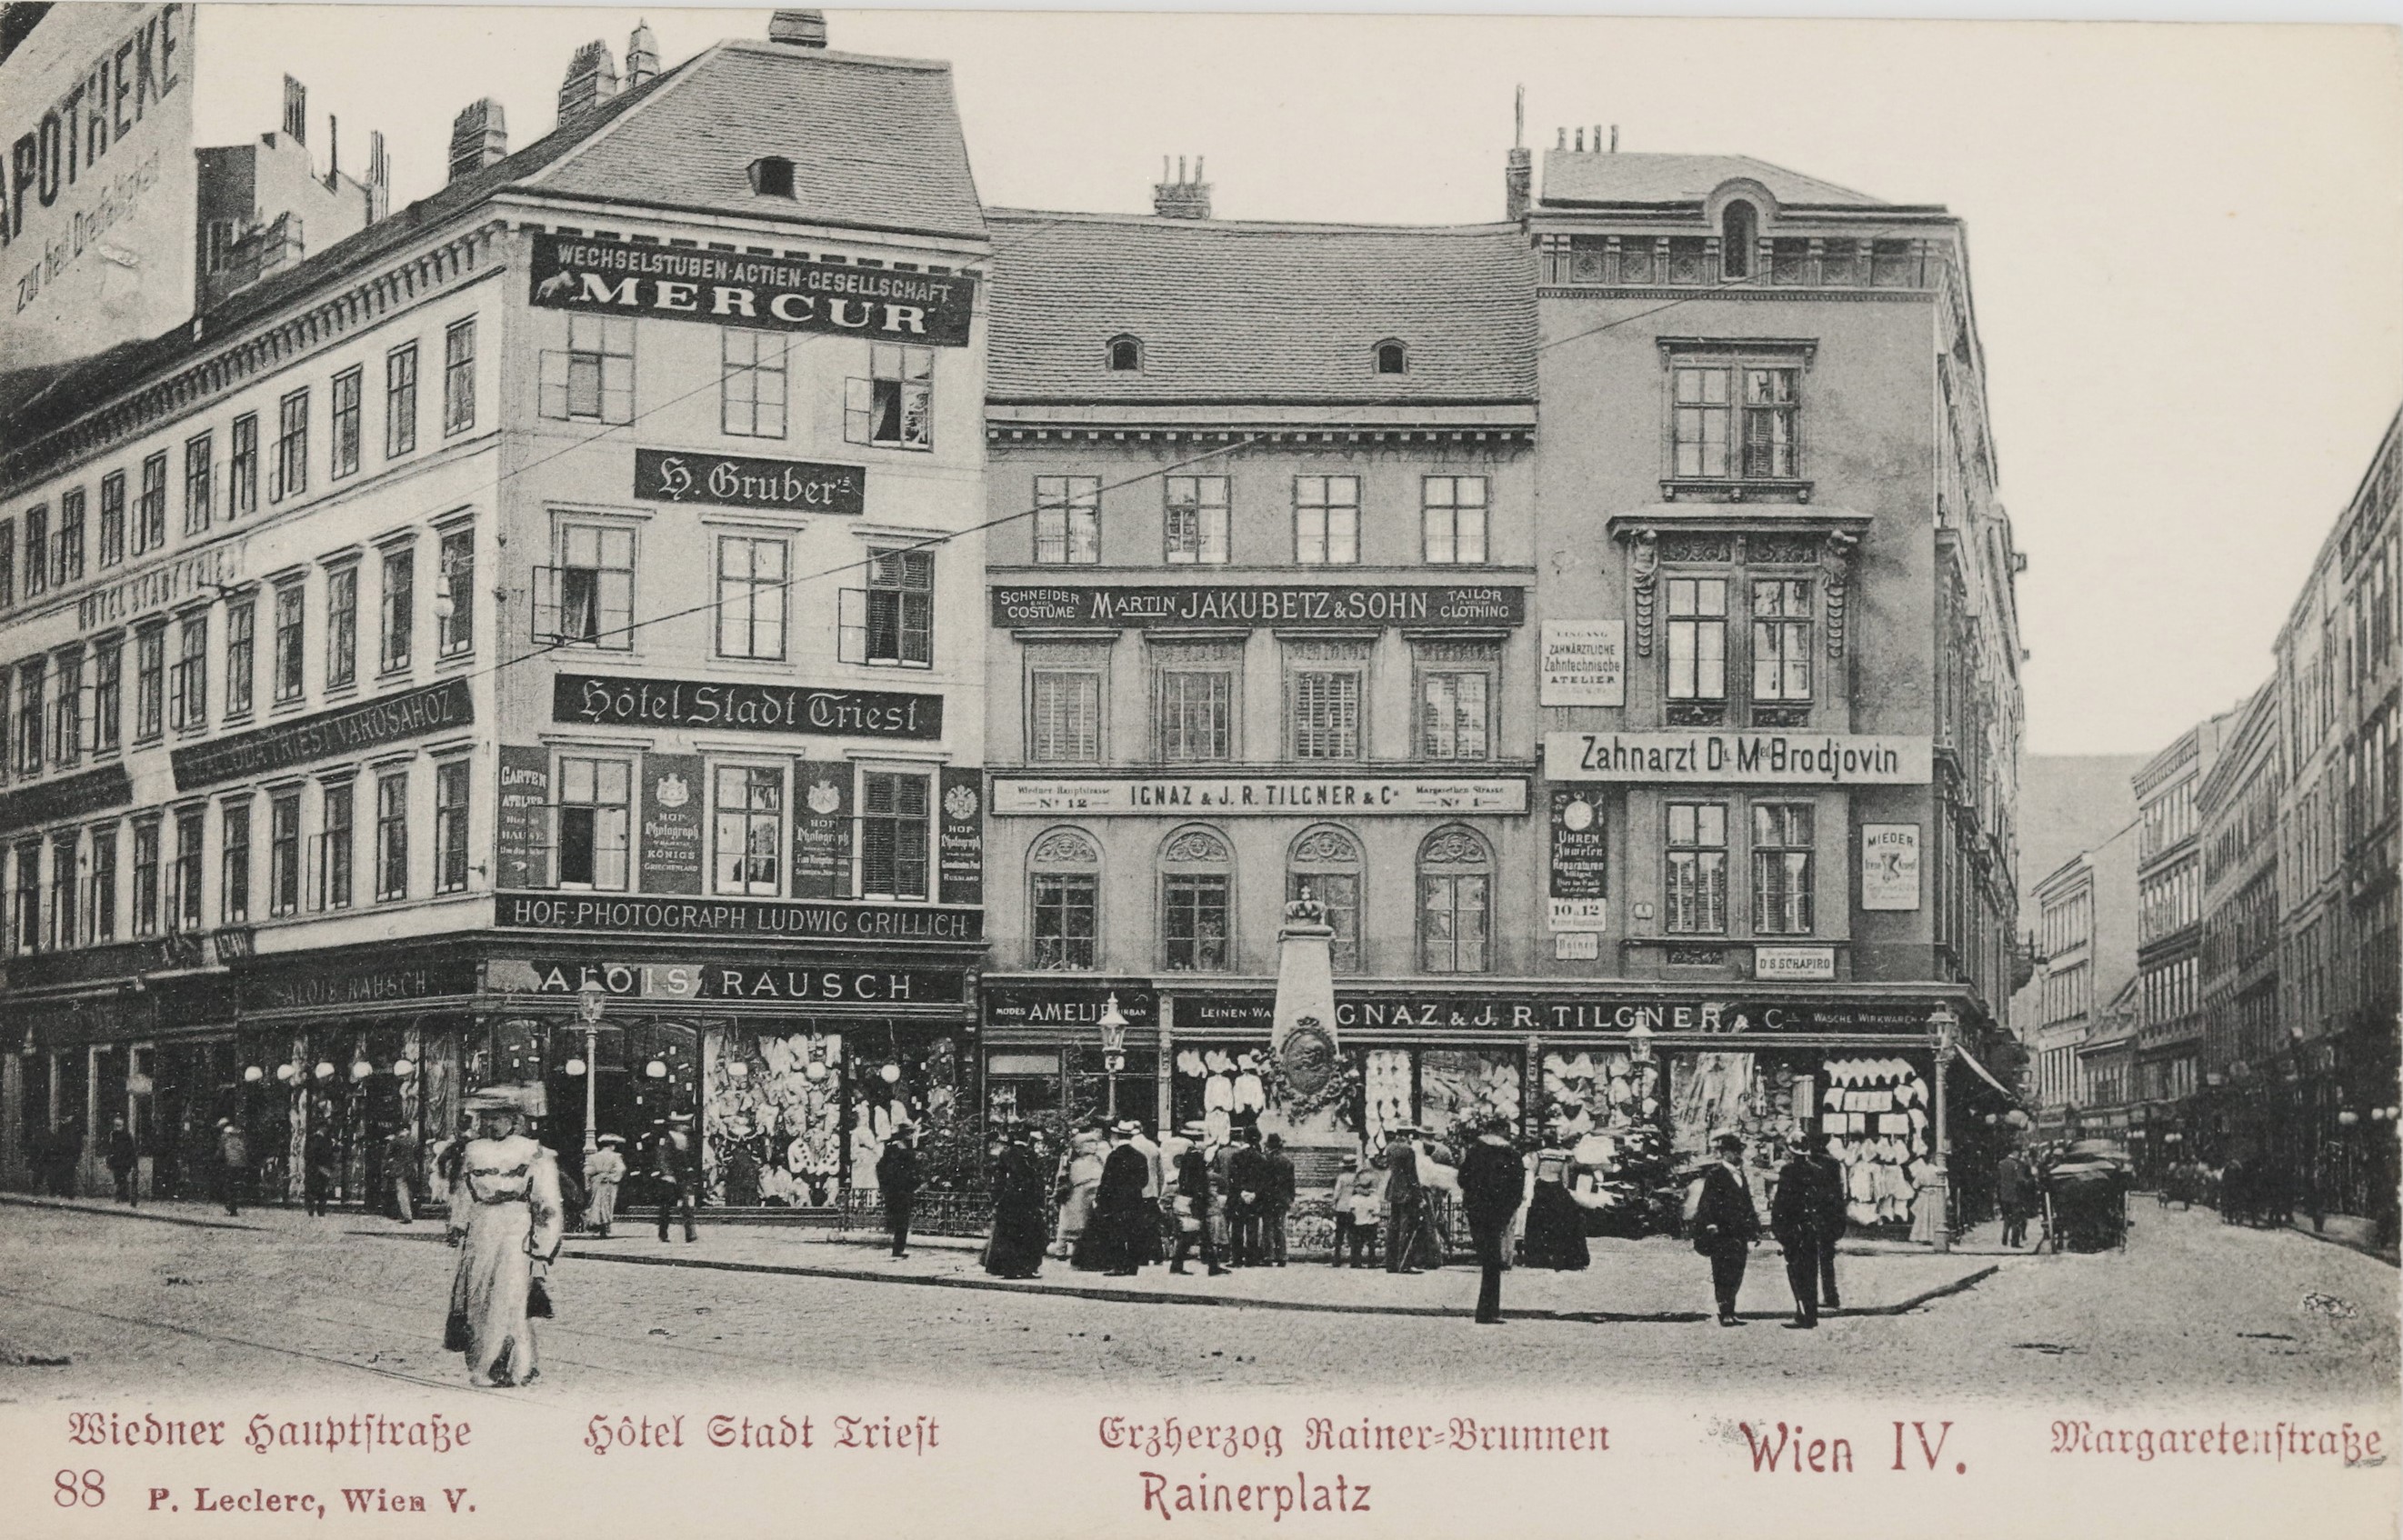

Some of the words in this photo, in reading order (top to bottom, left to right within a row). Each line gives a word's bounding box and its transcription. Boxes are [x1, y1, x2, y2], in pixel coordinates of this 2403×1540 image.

[657, 456, 701, 501] H.
[1000, 589, 1080, 605] SCHNEIDER
[1447, 589, 1502, 602] TAILOR
[1181, 592, 1330, 619] JAKUBETZ
[1348, 592, 1427, 619] SOHN
[1440, 605, 1509, 618] CLOTHING
[1549, 643, 1615, 655] ZAHNÄRZTLICHE
[1545, 656, 1620, 672] Zahntechnische
[1551, 675, 1615, 684] ATELIER
[686, 686, 796, 725] Stadt
[806, 693, 916, 732] Triest
[1580, 735, 1697, 773] Zahnarzt
[1771, 737, 1898, 782] Brodjovin
[501, 765, 547, 789] GARTEN
[1067, 798, 1088, 808] 12
[1130, 785, 1192, 806] IGNAZ
[1201, 793, 1213, 805] &
[1218, 786, 1235, 806] J.
[1242, 785, 1259, 806] R.
[1266, 785, 1356, 806] TILGNER
[1364, 792, 1375, 805] &
[645, 820, 699, 840] Photograph
[1558, 830, 1600, 844] UHREN
[1867, 832, 1914, 847] MIEDER
[1554, 905, 1573, 916] 10
[1582, 905, 1600, 916] 12
[757, 908, 847, 933] LUDWIG
[856, 911, 968, 937] GRILLICH
[1778, 958, 1830, 969] SCHAPIRO
[541, 965, 689, 995] ALOIS
[721, 969, 910, 1000] RAUSCH
[996, 1007, 1026, 1015] MODES
[1336, 1004, 1438, 1025] GNAZ
[1450, 1013, 1467, 1026] &
[1513, 1005, 1540, 1027] R.
[1552, 1005, 1721, 1029] TILGNER
